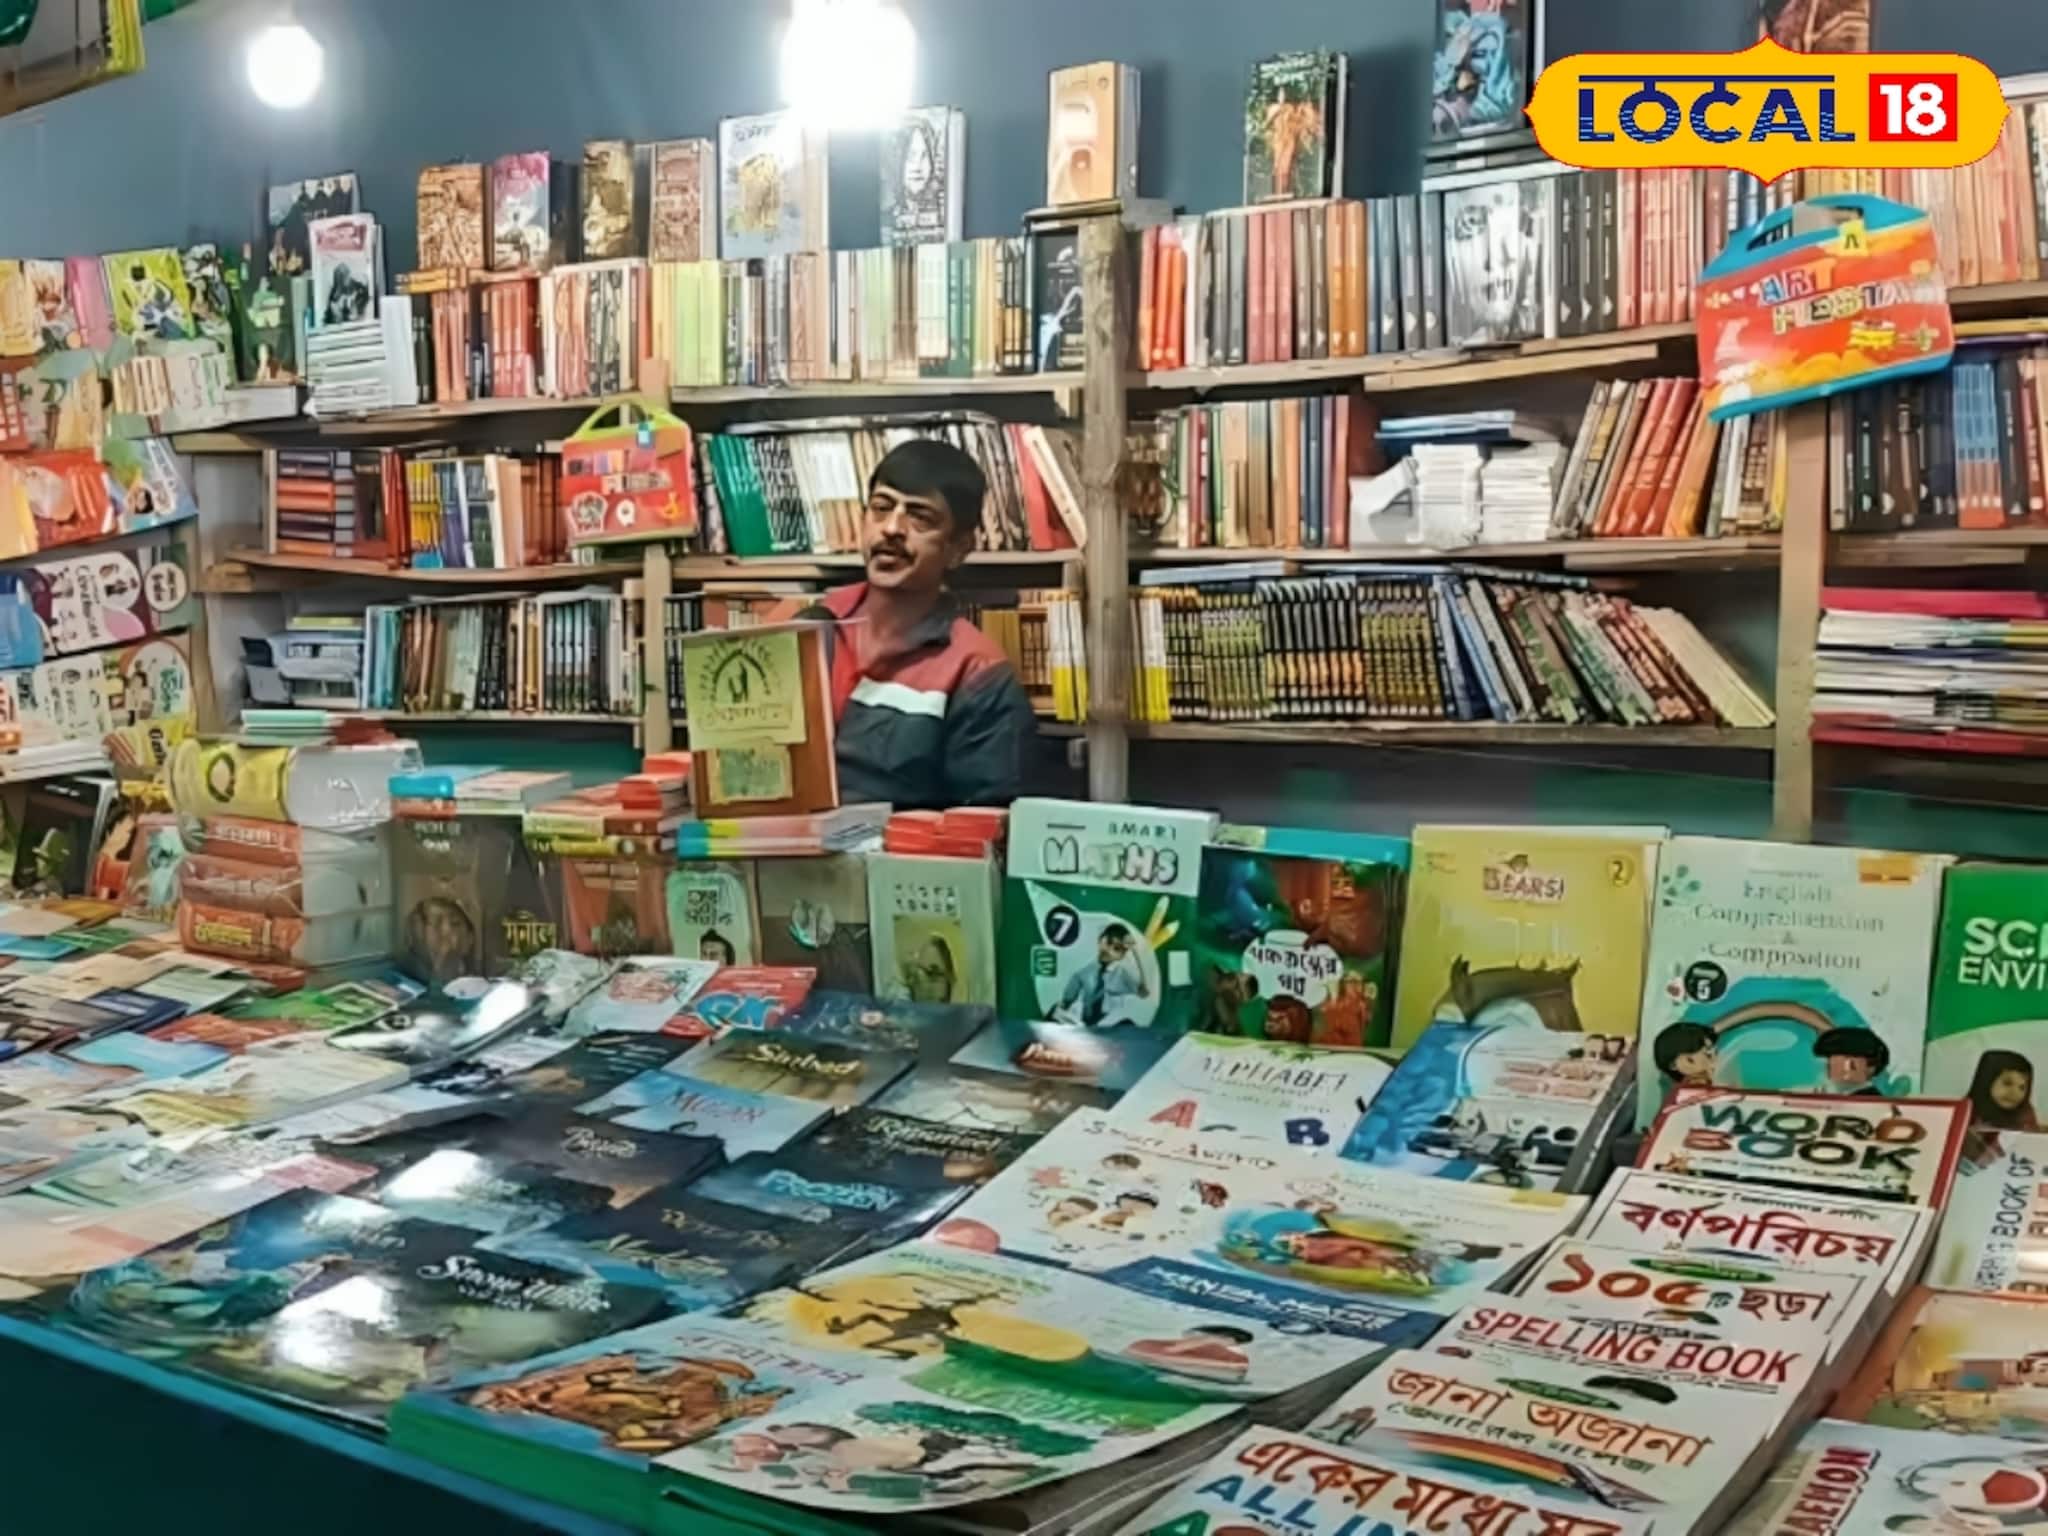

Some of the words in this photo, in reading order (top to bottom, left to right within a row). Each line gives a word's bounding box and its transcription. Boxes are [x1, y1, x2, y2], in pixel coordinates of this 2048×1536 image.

[1760, 258, 1835, 304] ART
[1052, 912, 1074, 942] 7
[1149, 1100, 1198, 1130] A
[1284, 1117, 1330, 1147] B
[1700, 1103, 1928, 1145] WORD
[1683, 1128, 1921, 1173] BOOK
[1620, 1200, 1897, 1267] বর্ণপরিচয়
[1463, 1307, 1663, 1364] SPELLING
[1664, 1342, 1803, 1383] BOOK
[1387, 1367, 1514, 1421] জানা
[1526, 1399, 1715, 1468] অজানা
[1237, 1440, 1398, 1511] একের
[1195, 1474, 1319, 1530] ALL
